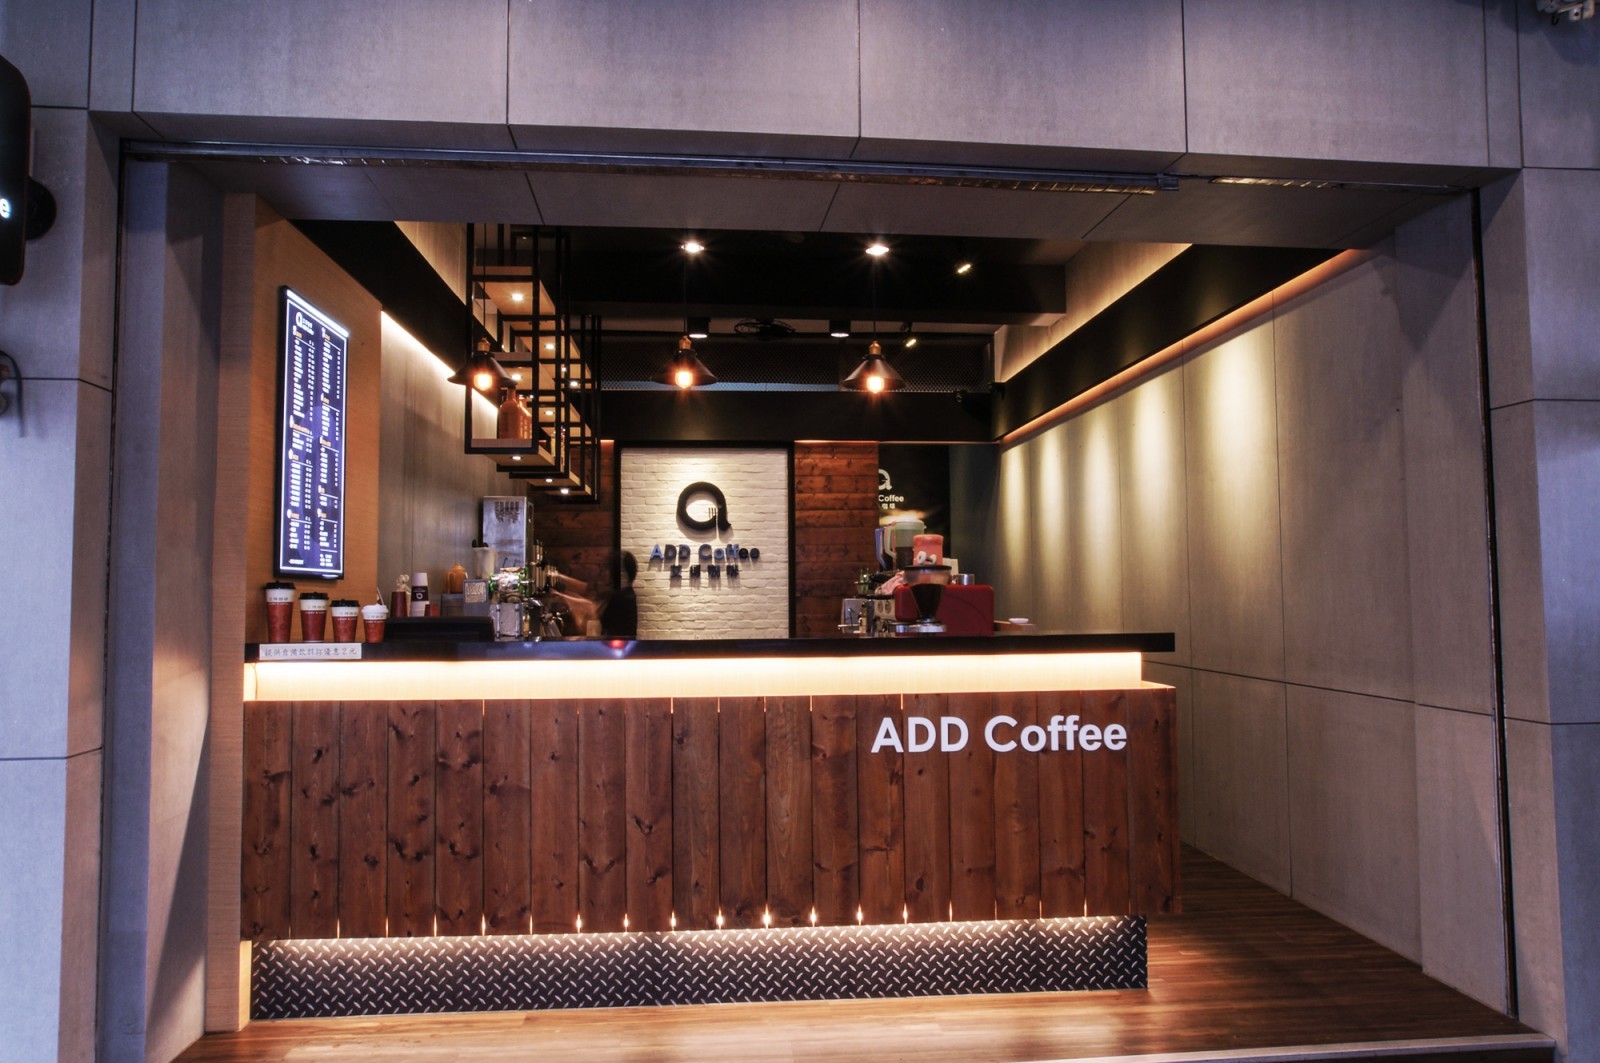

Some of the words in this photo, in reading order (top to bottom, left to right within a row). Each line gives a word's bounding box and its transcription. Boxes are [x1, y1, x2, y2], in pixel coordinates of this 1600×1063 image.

[878, 494, 905, 502] Coffee
[650, 543, 691, 561] ADD
[698, 543, 760, 560] Coffee
[871, 716, 969, 753] ADD
[984, 714, 1127, 753] Coffee
